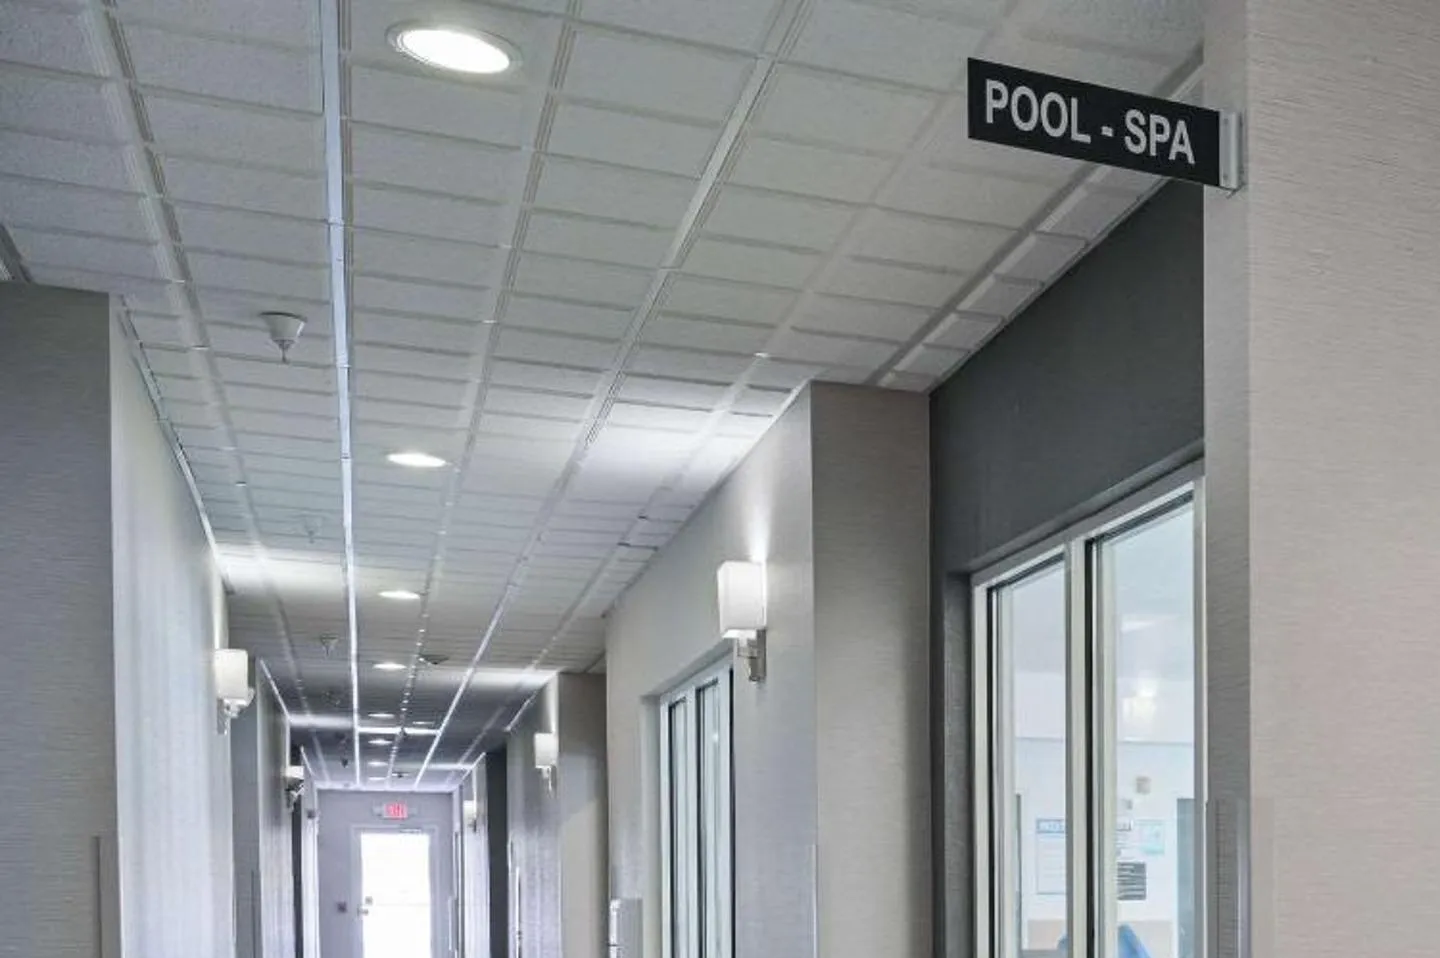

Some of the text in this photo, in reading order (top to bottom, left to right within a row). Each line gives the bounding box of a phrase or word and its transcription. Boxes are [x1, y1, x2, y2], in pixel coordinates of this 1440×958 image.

[985, 78, 1196, 165] POOL - SPA
